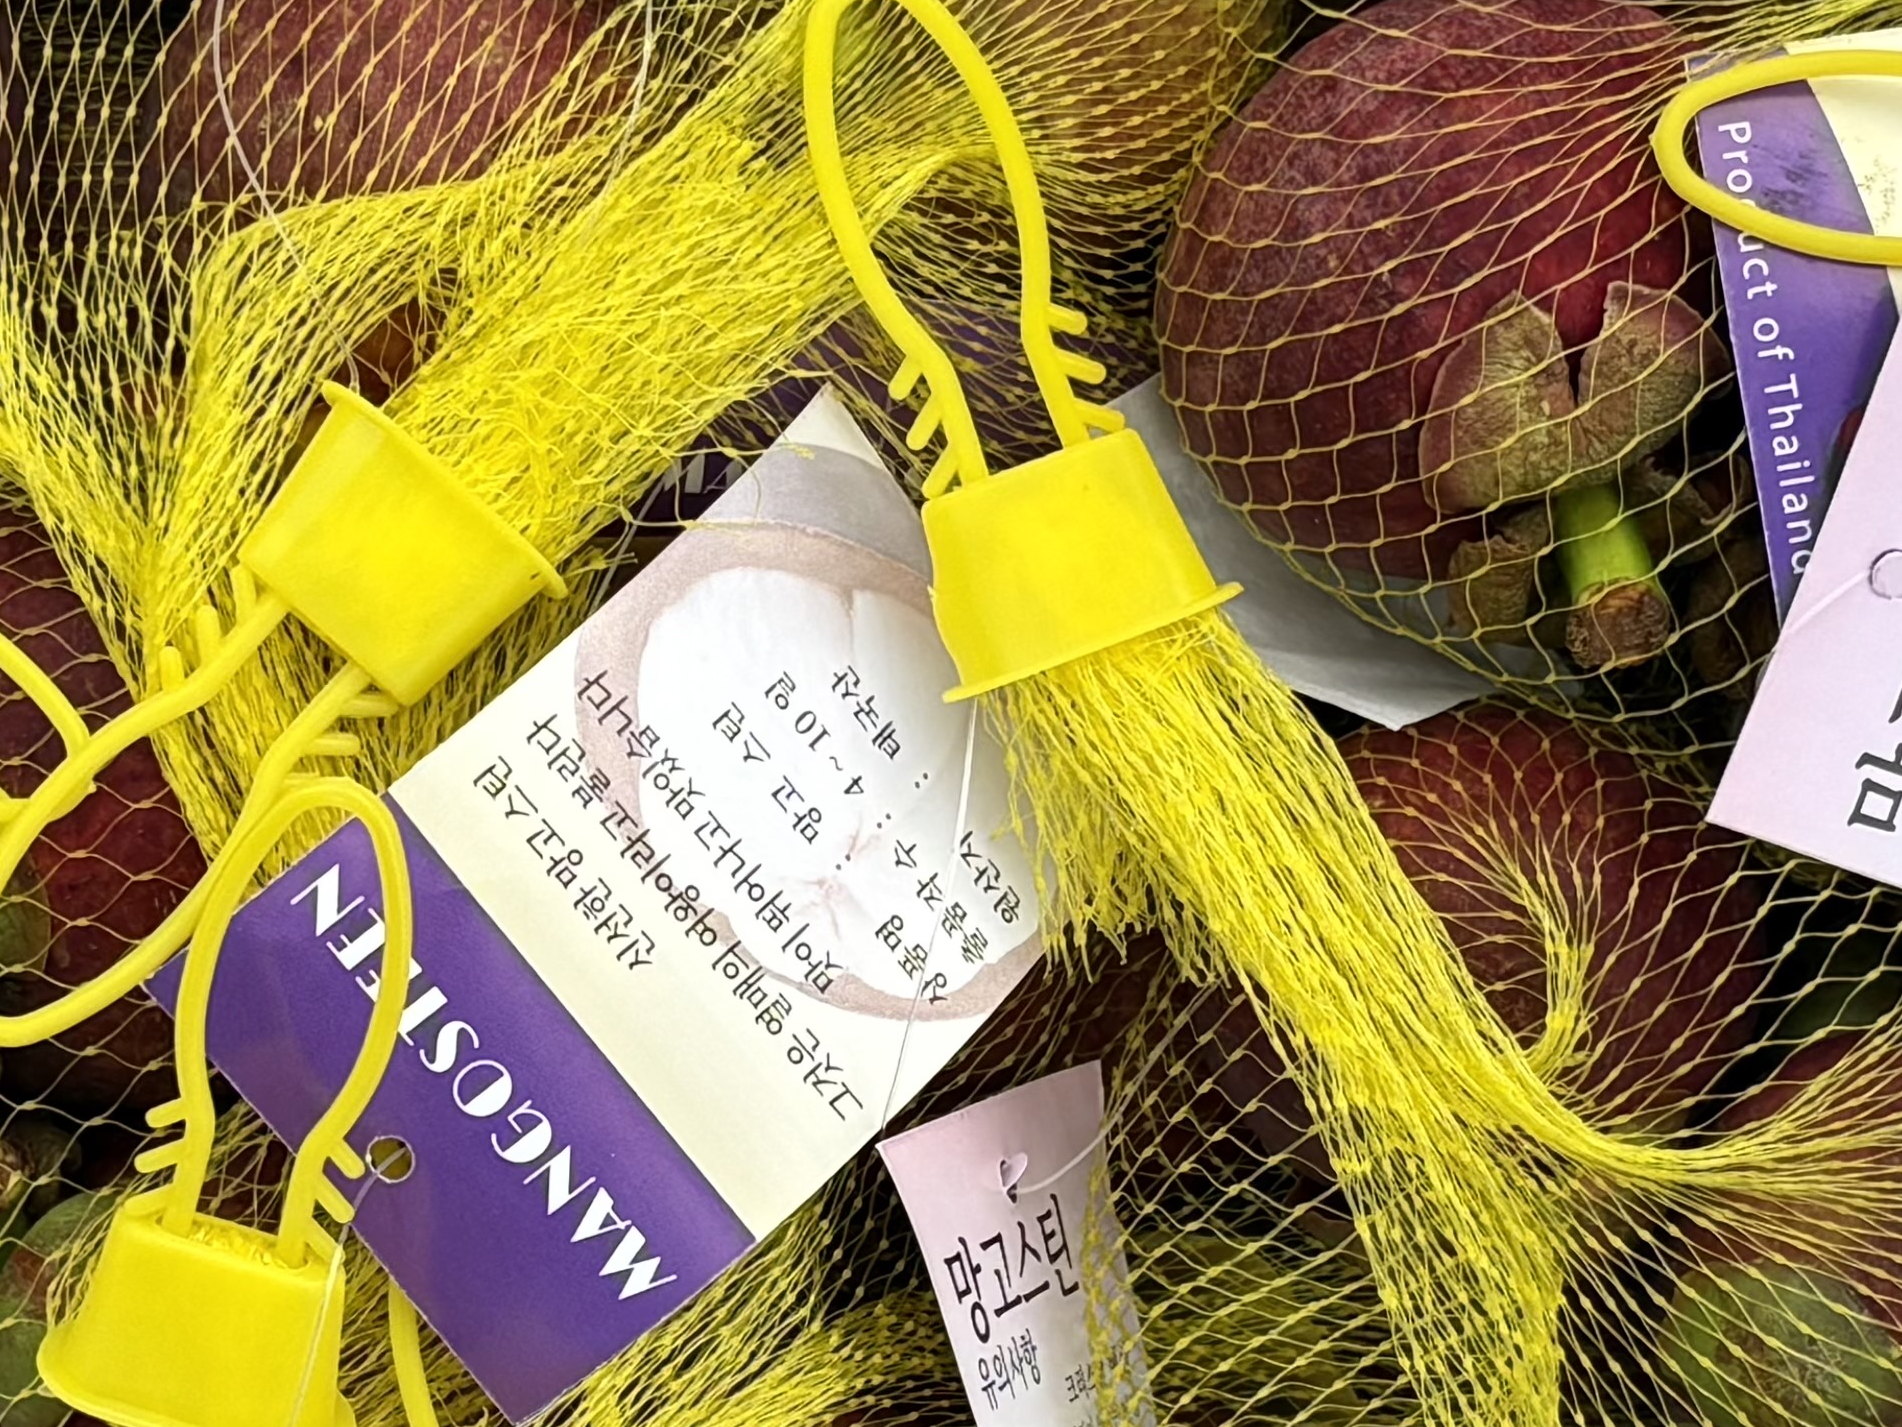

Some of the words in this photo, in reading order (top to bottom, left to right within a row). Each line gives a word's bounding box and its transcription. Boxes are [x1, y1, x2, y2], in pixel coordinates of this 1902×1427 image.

[1716, 120, 1777, 300] Prouct
[1752, 317, 1794, 360] of
[711, 700, 771, 762] 스틴
[763, 669, 796, 710] 일
[793, 709, 831, 751] 10
[830, 664, 901, 760] 태국산
[472, 754, 539, 819] 스틴
[525, 712, 611, 810] 불린다
[576, 668, 705, 821] 맛있습니다
[842, 774, 864, 795] 4
[524, 817, 584, 890] 망고
[770, 774, 822, 845] 망고
[893, 838, 917, 868] 수
[598, 799, 718, 947] 여왕이라고
[692, 809, 792, 933] 뛰어나고
[915, 871, 989, 964] 출품작
[958, 829, 1021, 924] 원산지
[572, 876, 656, 970] 신선한
[780, 921, 843, 995] 맛이
[873, 913, 948, 1005] 상품명
[710, 938, 792, 1035] 열매의
[289, 862, 677, 1300] MANGOSTEEN
[785, 1026, 864, 1121] 그것은
[942, 1192, 1080, 1344] 망고스틴
[977, 1327, 1041, 1411] 유의사항
